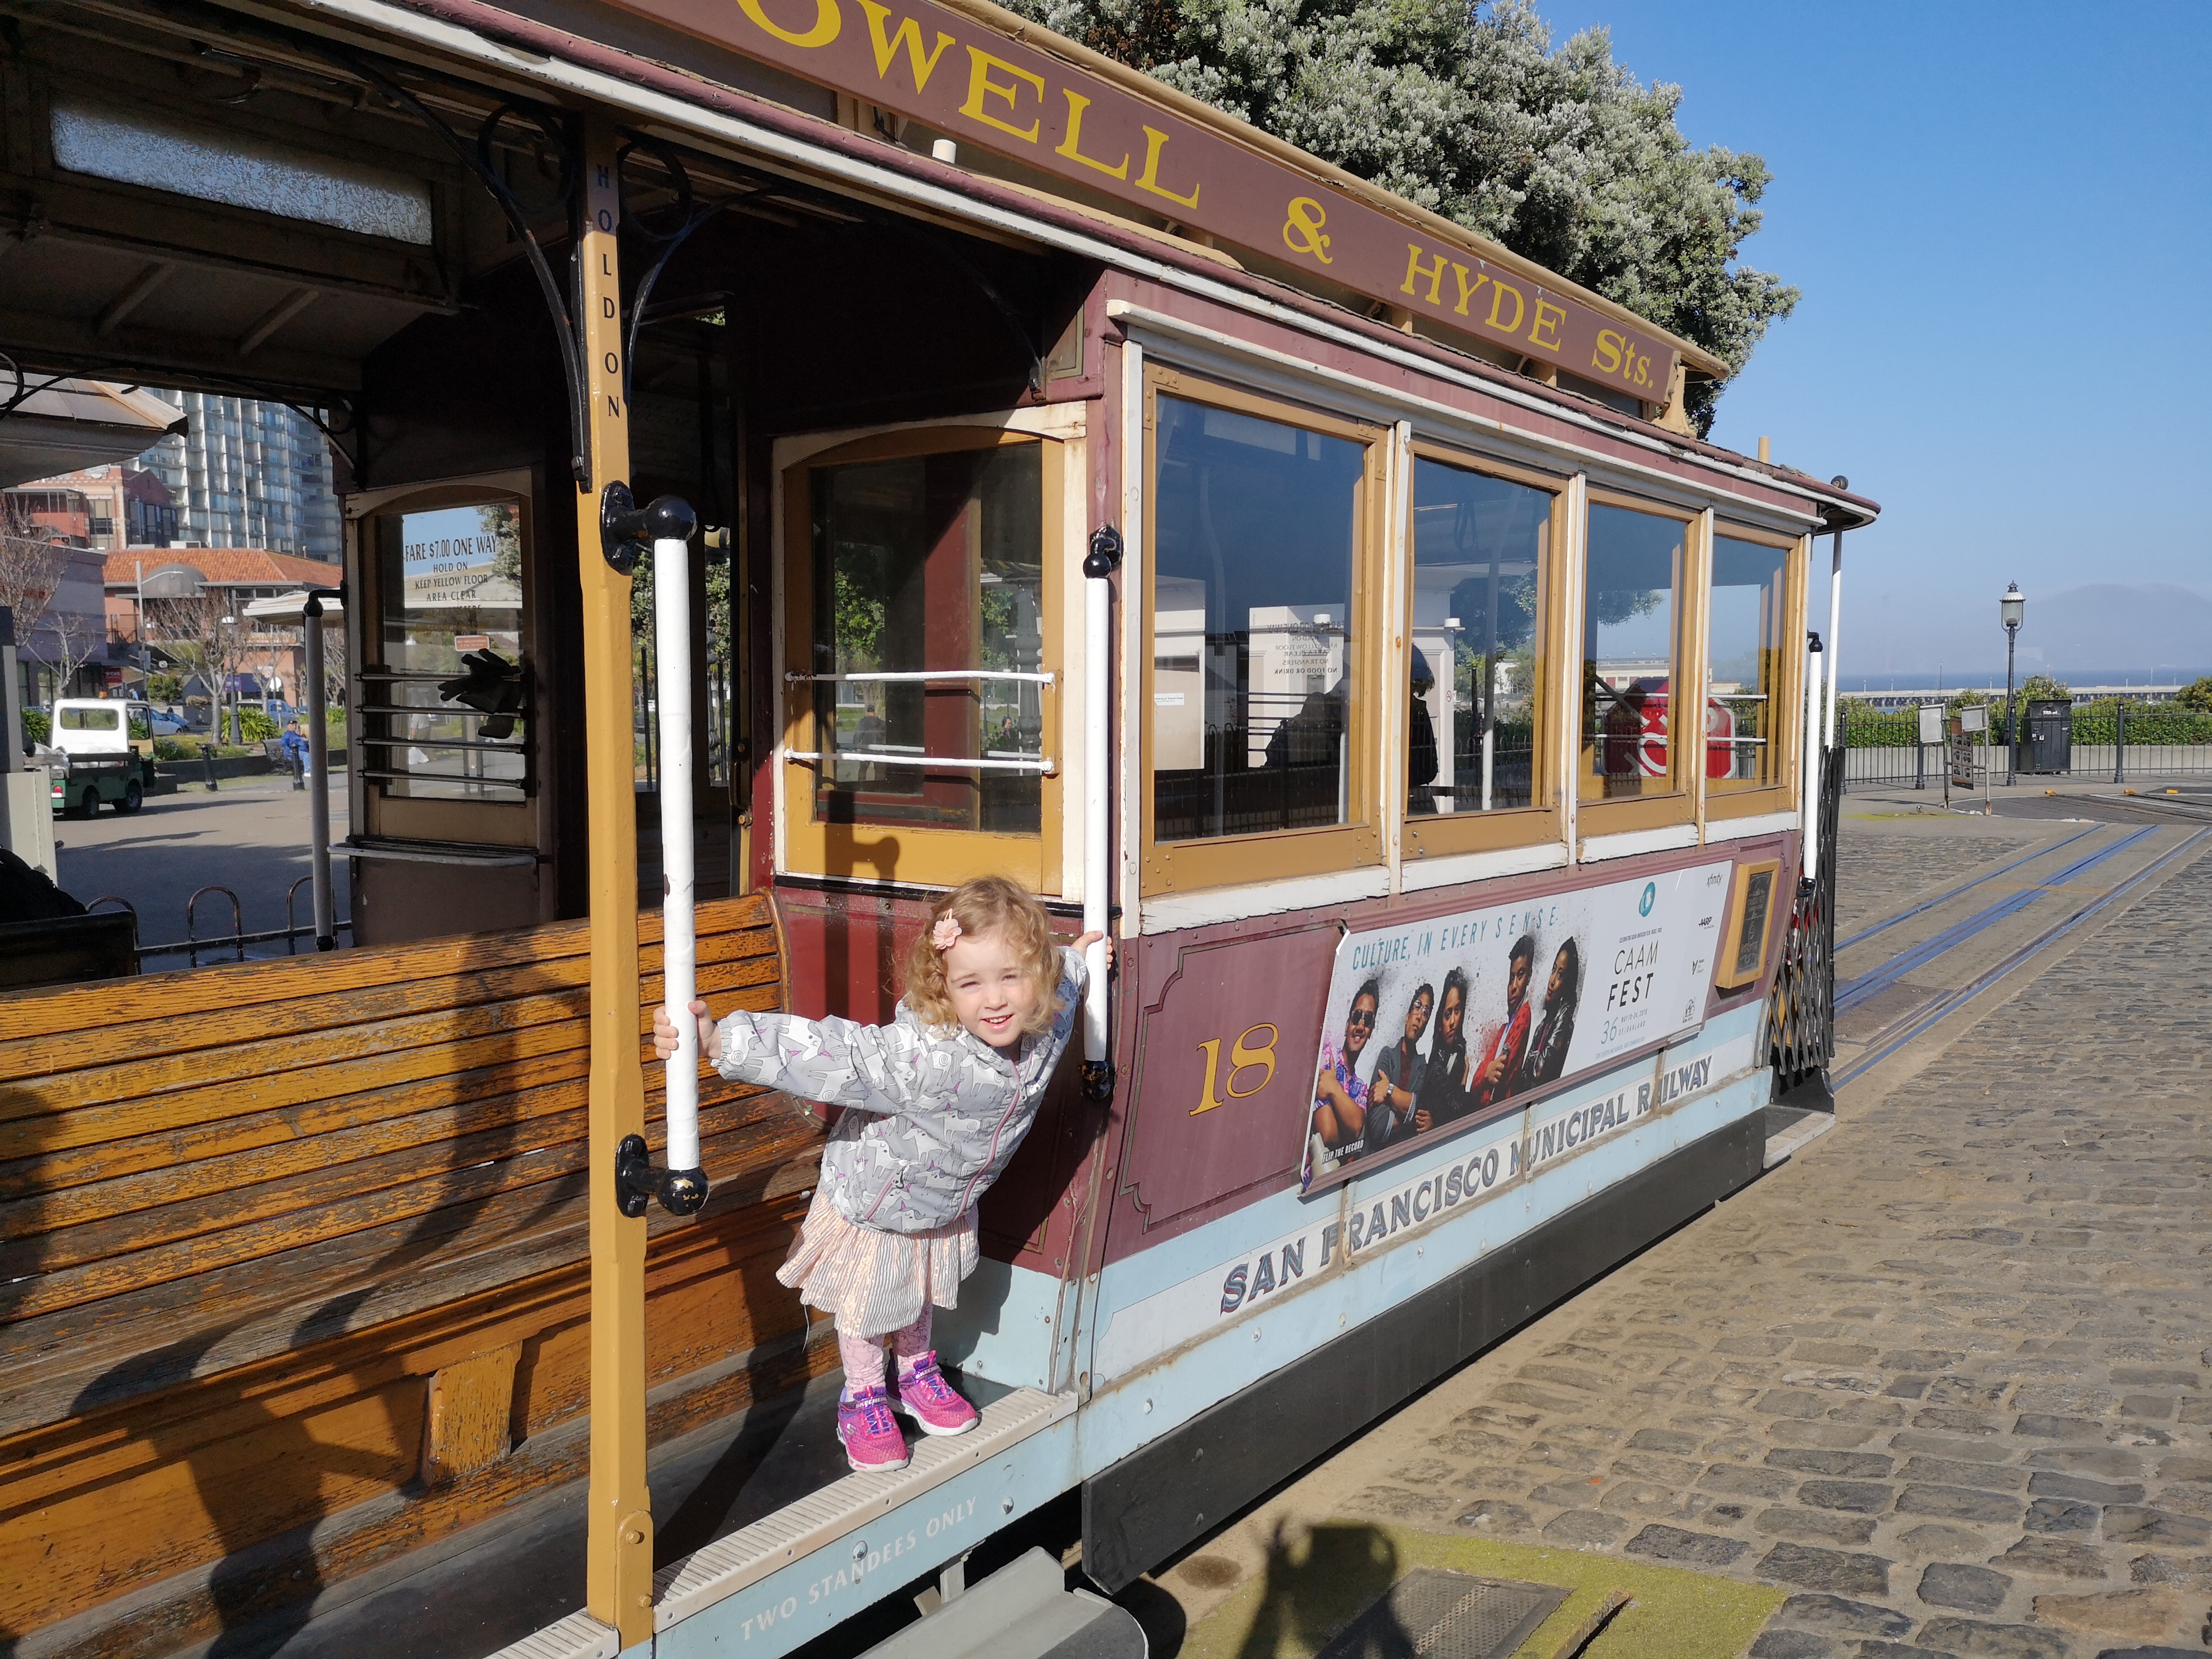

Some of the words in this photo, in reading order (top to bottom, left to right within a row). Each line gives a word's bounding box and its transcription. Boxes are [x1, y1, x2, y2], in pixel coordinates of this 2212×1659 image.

[596, 163, 615, 319] HOLD
[1282, 197, 1333, 264] &
[1400, 243, 1566, 352] HYDE
[1592, 329, 1653, 389] Sts.
[604, 352, 620, 419] ON
[405, 543, 426, 562] FARE
[429, 539, 450, 559] $7.00
[453, 537, 473, 556] ONE
[477, 535, 497, 554] WAY
[433, 563, 453, 573] HOLD
[457, 561, 468, 571] ON
[415, 579, 431, 589] KEEP
[434, 576, 462, 588] YELLOW
[464, 574, 488, 585] FLOOR
[426, 593, 447, 602] AREA
[451, 590, 476, 600] CLEAR
[1352, 937, 1410, 971] CULTURE,
[1417, 932, 1432, 955] IN
[1440, 920, 1487, 950] EVERY
[1496, 906, 1556, 939] SENSE
[1614, 940, 1658, 974] CAAM
[1607, 972, 1654, 1012] FEST
[1601, 1017, 1618, 1044] 36
[1189, 1022, 1279, 1117] 18
[1322, 1151, 1334, 1162] FLIP
[1335, 1147, 1344, 1158] THE
[1345, 1139, 1364, 1154] RECORD
[1220, 1236, 1306, 1317] SAN
[1320, 1148, 1499, 1268] FRANCISCO
[1509, 1093, 1631, 1176] MUNICIPAL
[741, 1596, 798, 1641] TWO
[809, 1529, 917, 1605] STANDEES
[925, 1496, 977, 1538] ONLY
